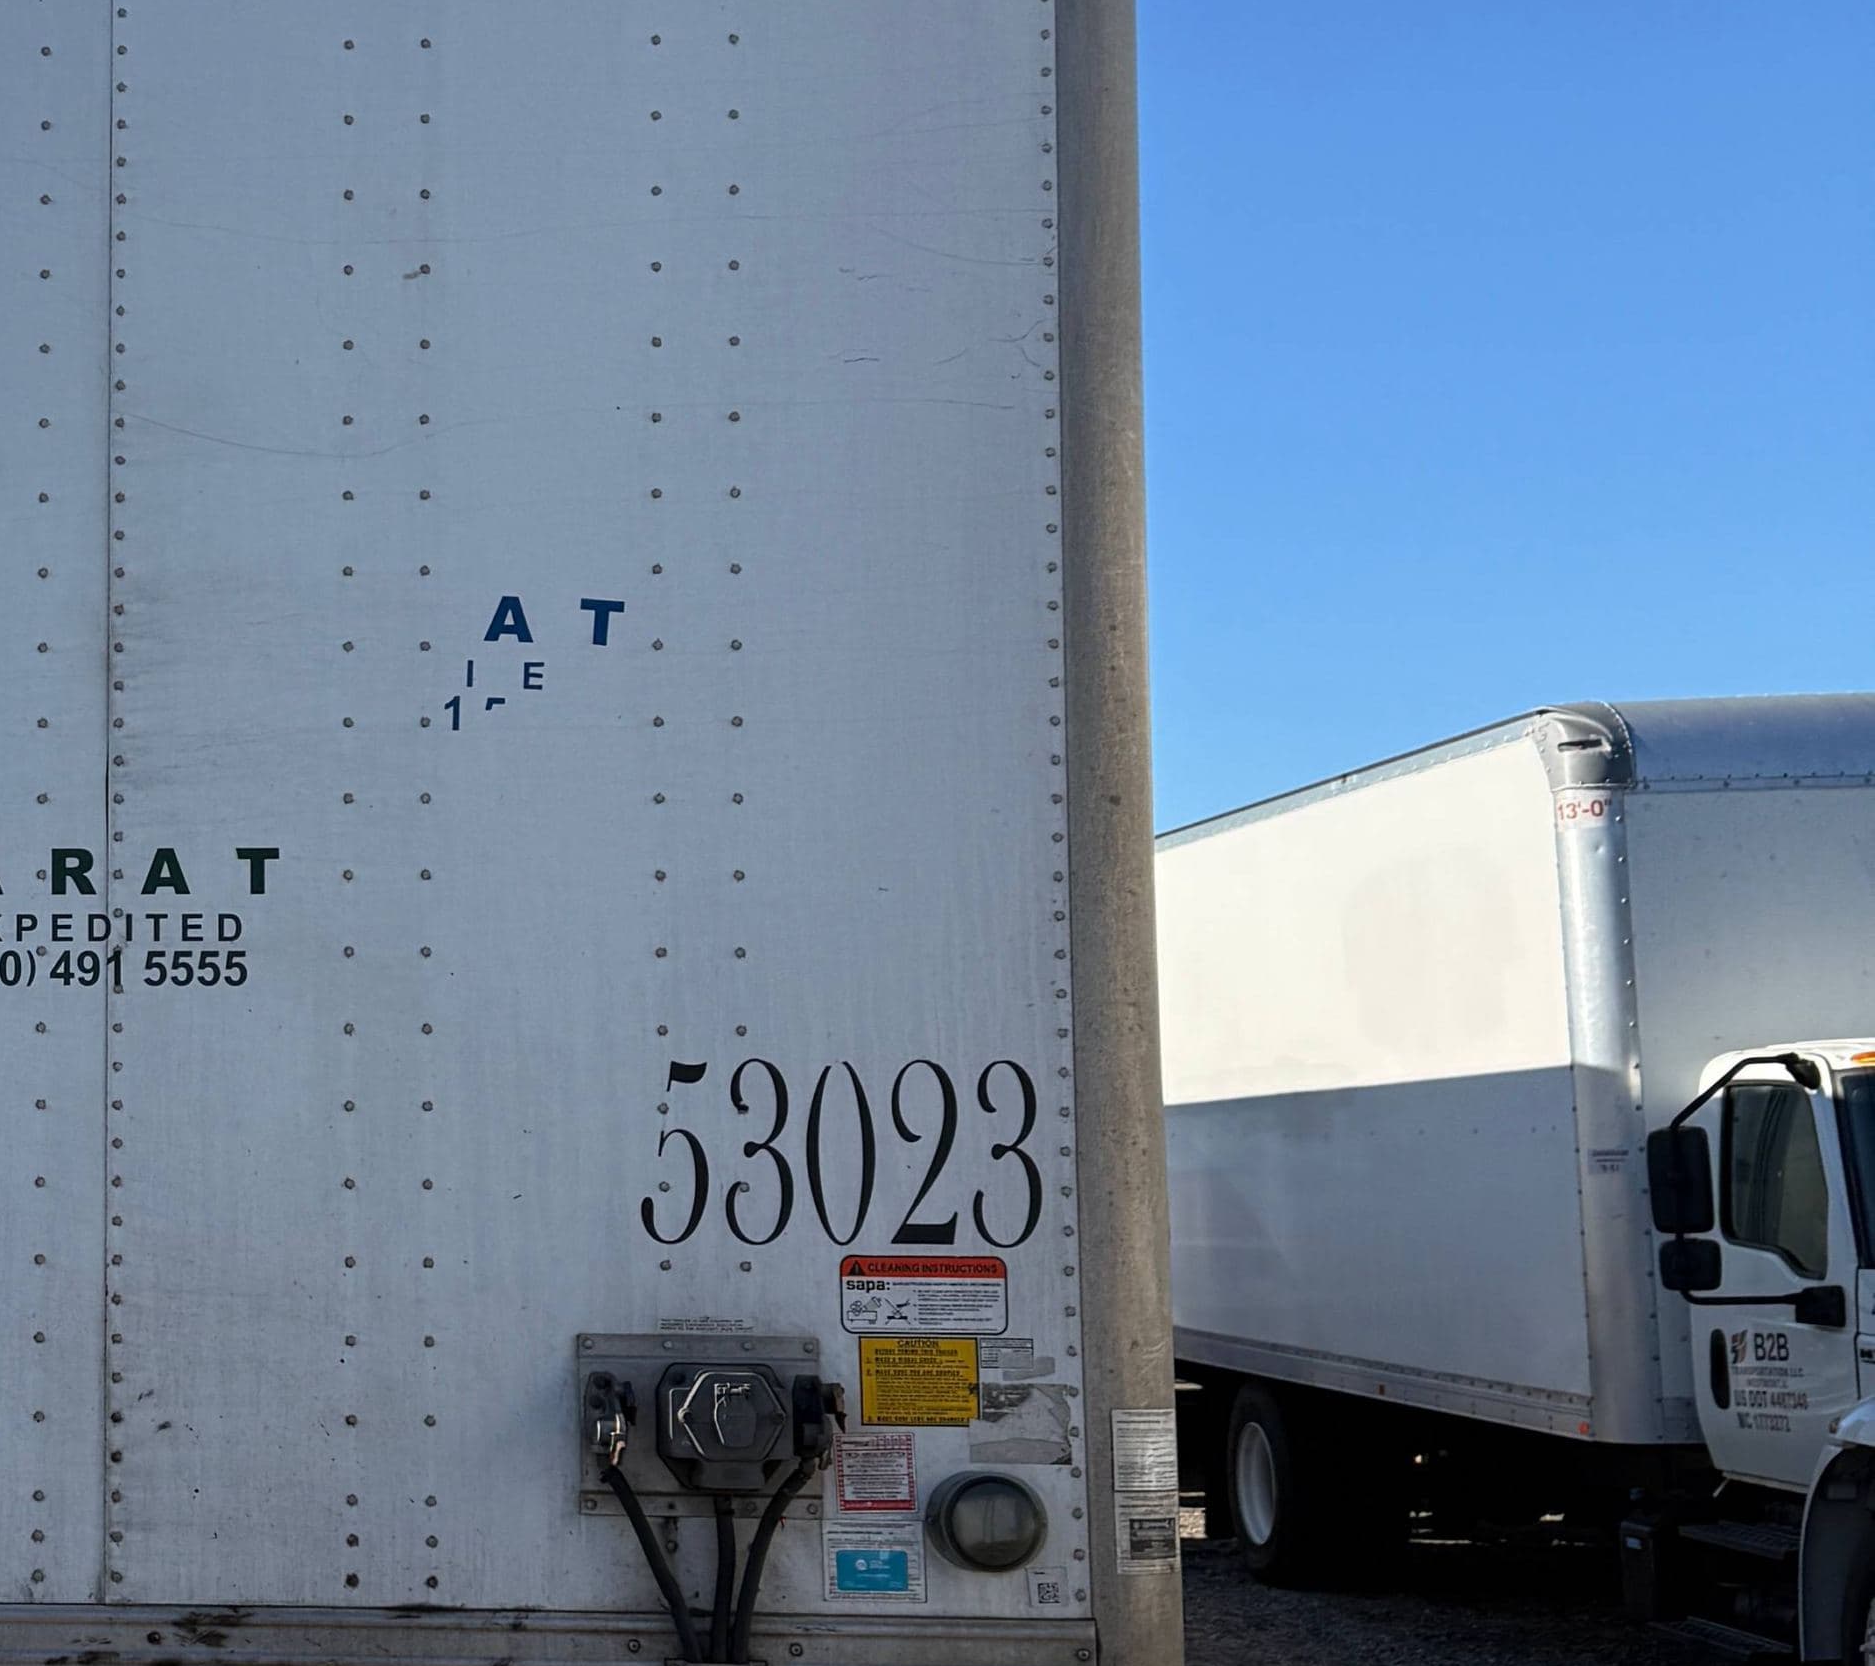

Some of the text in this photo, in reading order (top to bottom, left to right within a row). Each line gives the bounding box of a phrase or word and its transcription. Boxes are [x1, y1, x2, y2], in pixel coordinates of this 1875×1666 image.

[1557, 799, 1613, 821] 13'-0"
[49, 949, 123, 987] 491
[143, 949, 248, 987] 5555
[641, 1058, 1042, 1248] 53023
[868, 1262, 998, 1274] CLEANING INSTRUCTIONS
[897, 1339, 940, 1349] CAUTION
[1754, 1333, 1790, 1361] B2B
